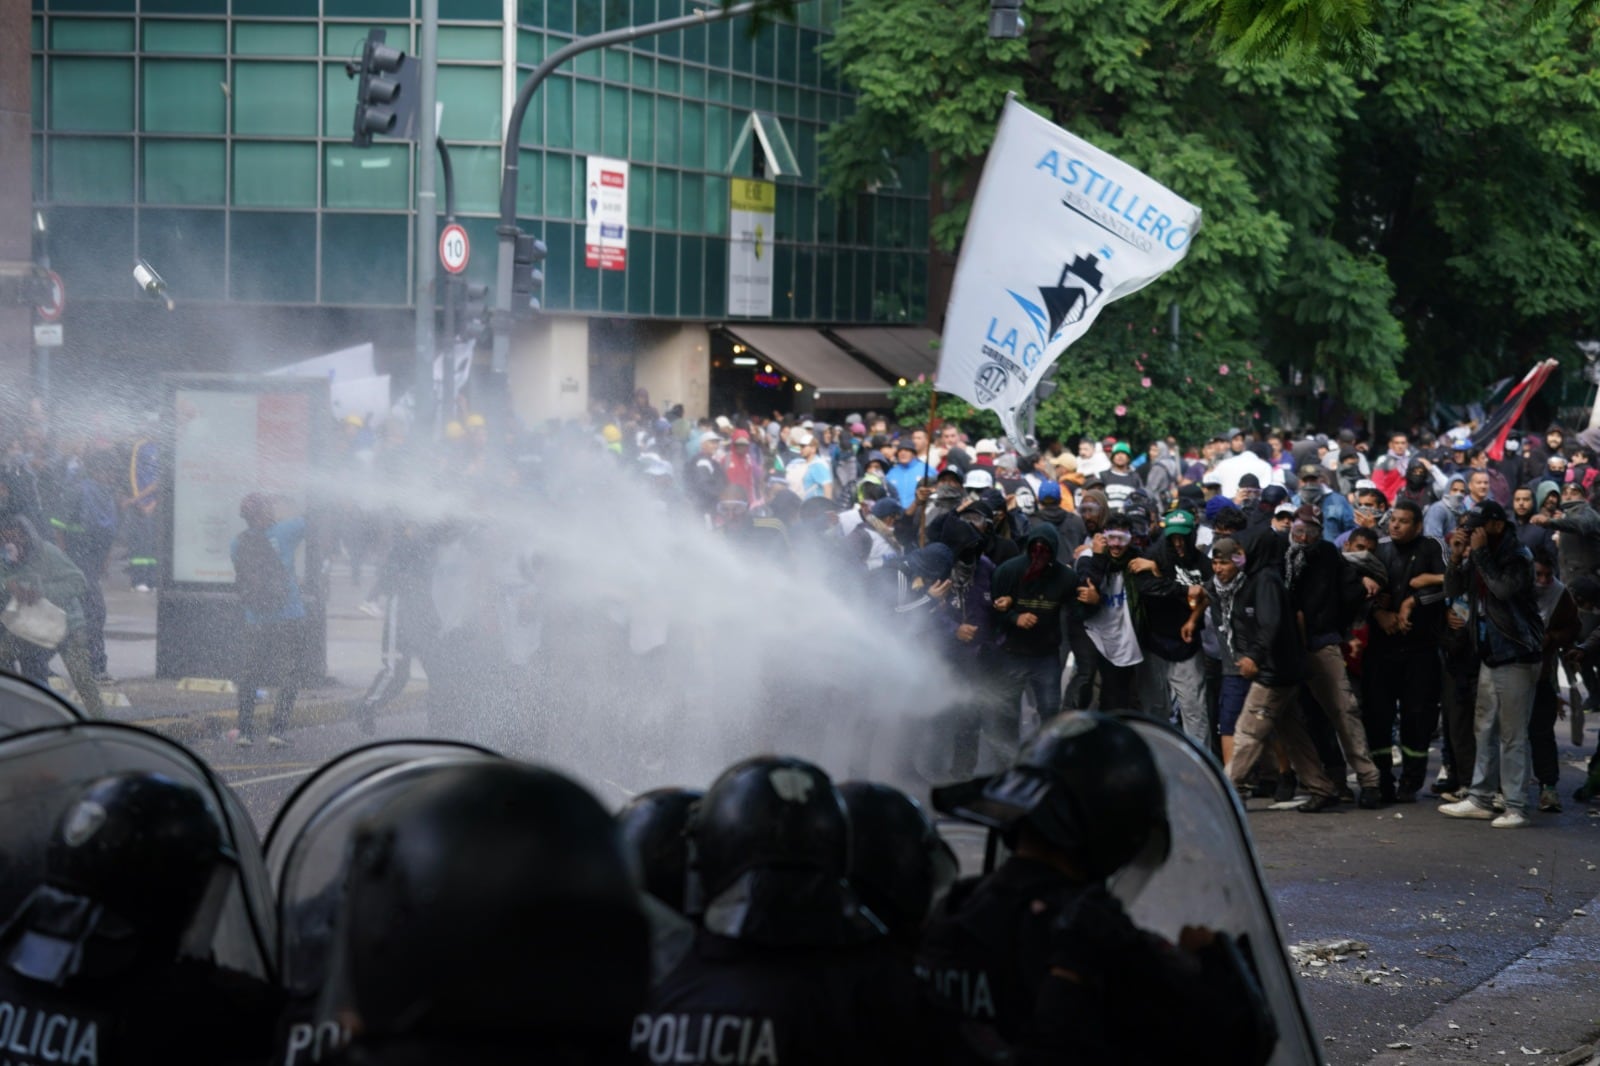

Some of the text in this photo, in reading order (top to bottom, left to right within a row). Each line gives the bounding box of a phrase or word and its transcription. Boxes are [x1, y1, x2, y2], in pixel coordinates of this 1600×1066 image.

[1035, 149, 1190, 251] ASTILLERO
[447, 239, 463, 259] 10
[986, 316, 1018, 356] LA
[630, 1013, 778, 1066] POLICIA
